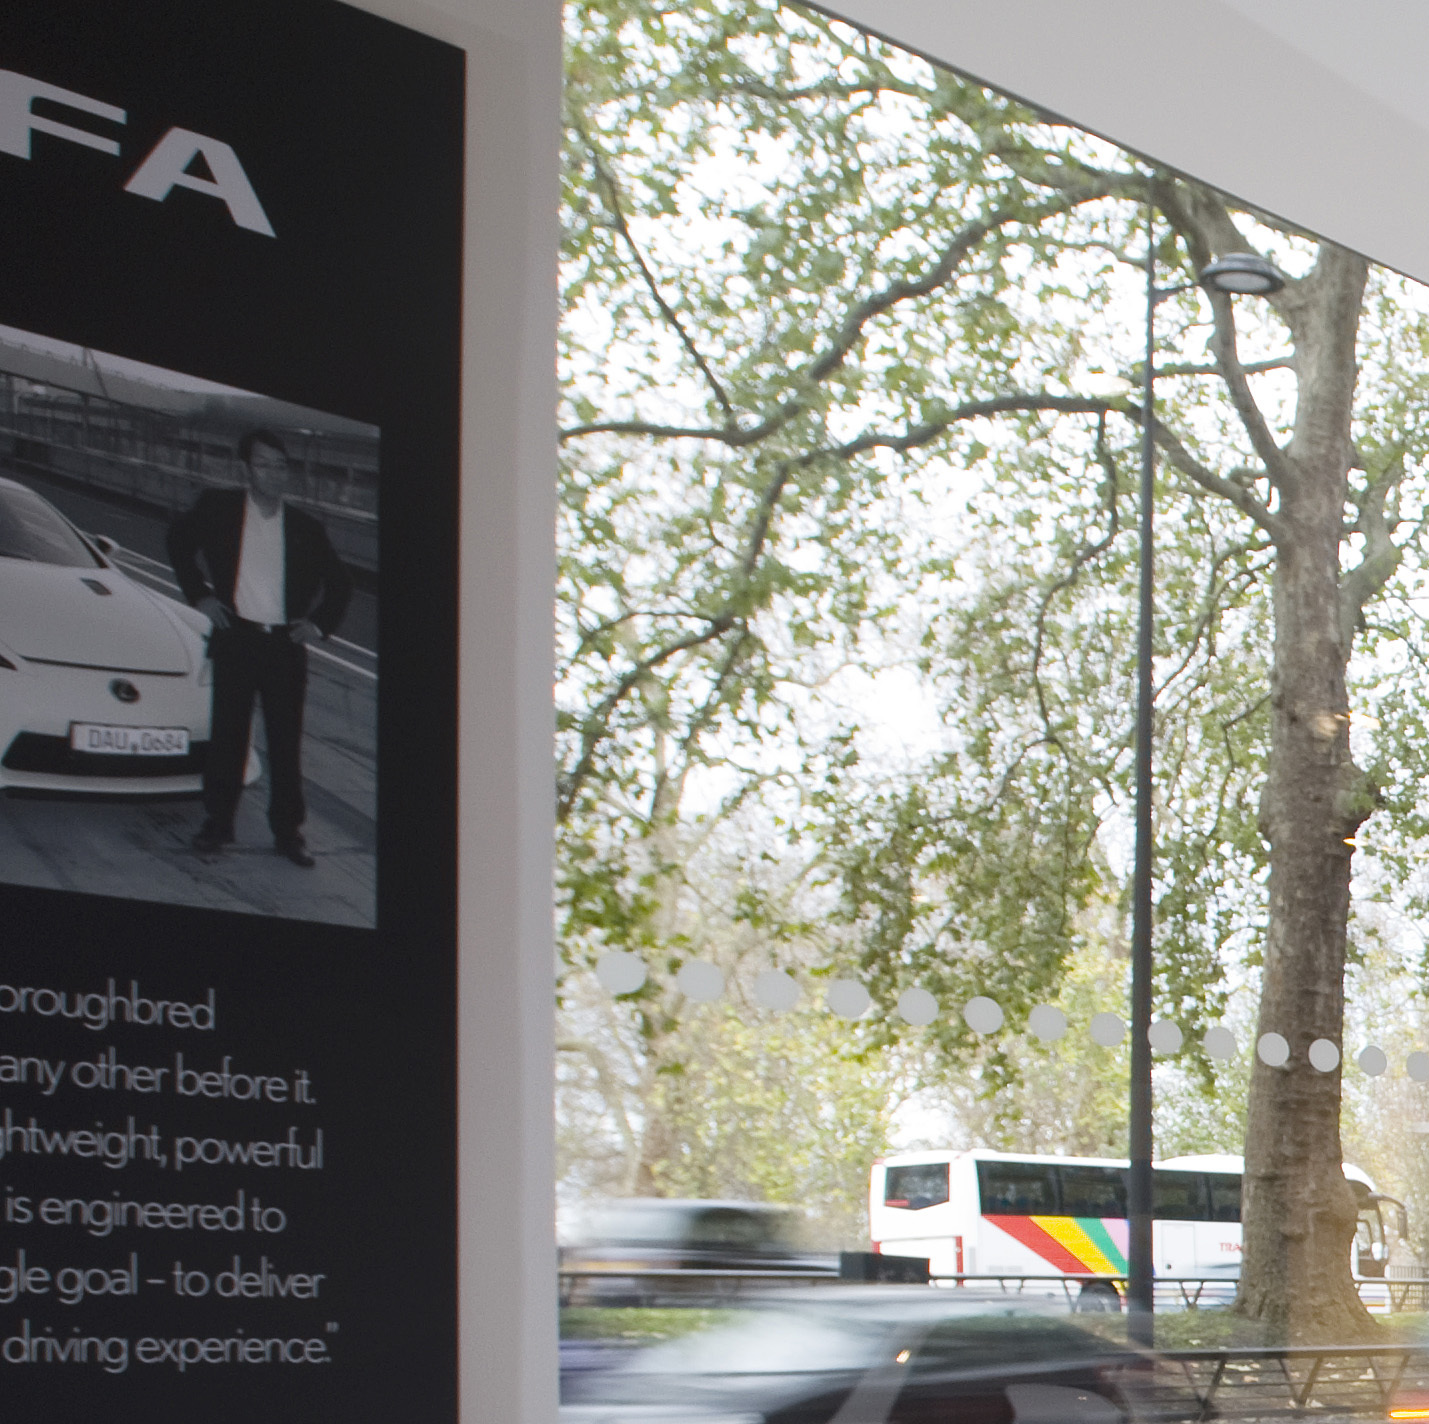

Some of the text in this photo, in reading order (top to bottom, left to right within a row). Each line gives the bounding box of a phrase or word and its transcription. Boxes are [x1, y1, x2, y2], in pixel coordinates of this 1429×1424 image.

[0, 69, 275, 237] FA
[0, 979, 214, 1030] oroughbred
[0, 1048, 315, 1103] any other before it.
[0, 1109, 322, 1170] htweight, powerful
[7, 1187, 285, 1236] is engineered to
[57, 1253, 137, 1304] goal
[173, 1262, 209, 1296] to
[216, 1256, 325, 1298] deliver
[3, 1319, 127, 1373] driving
